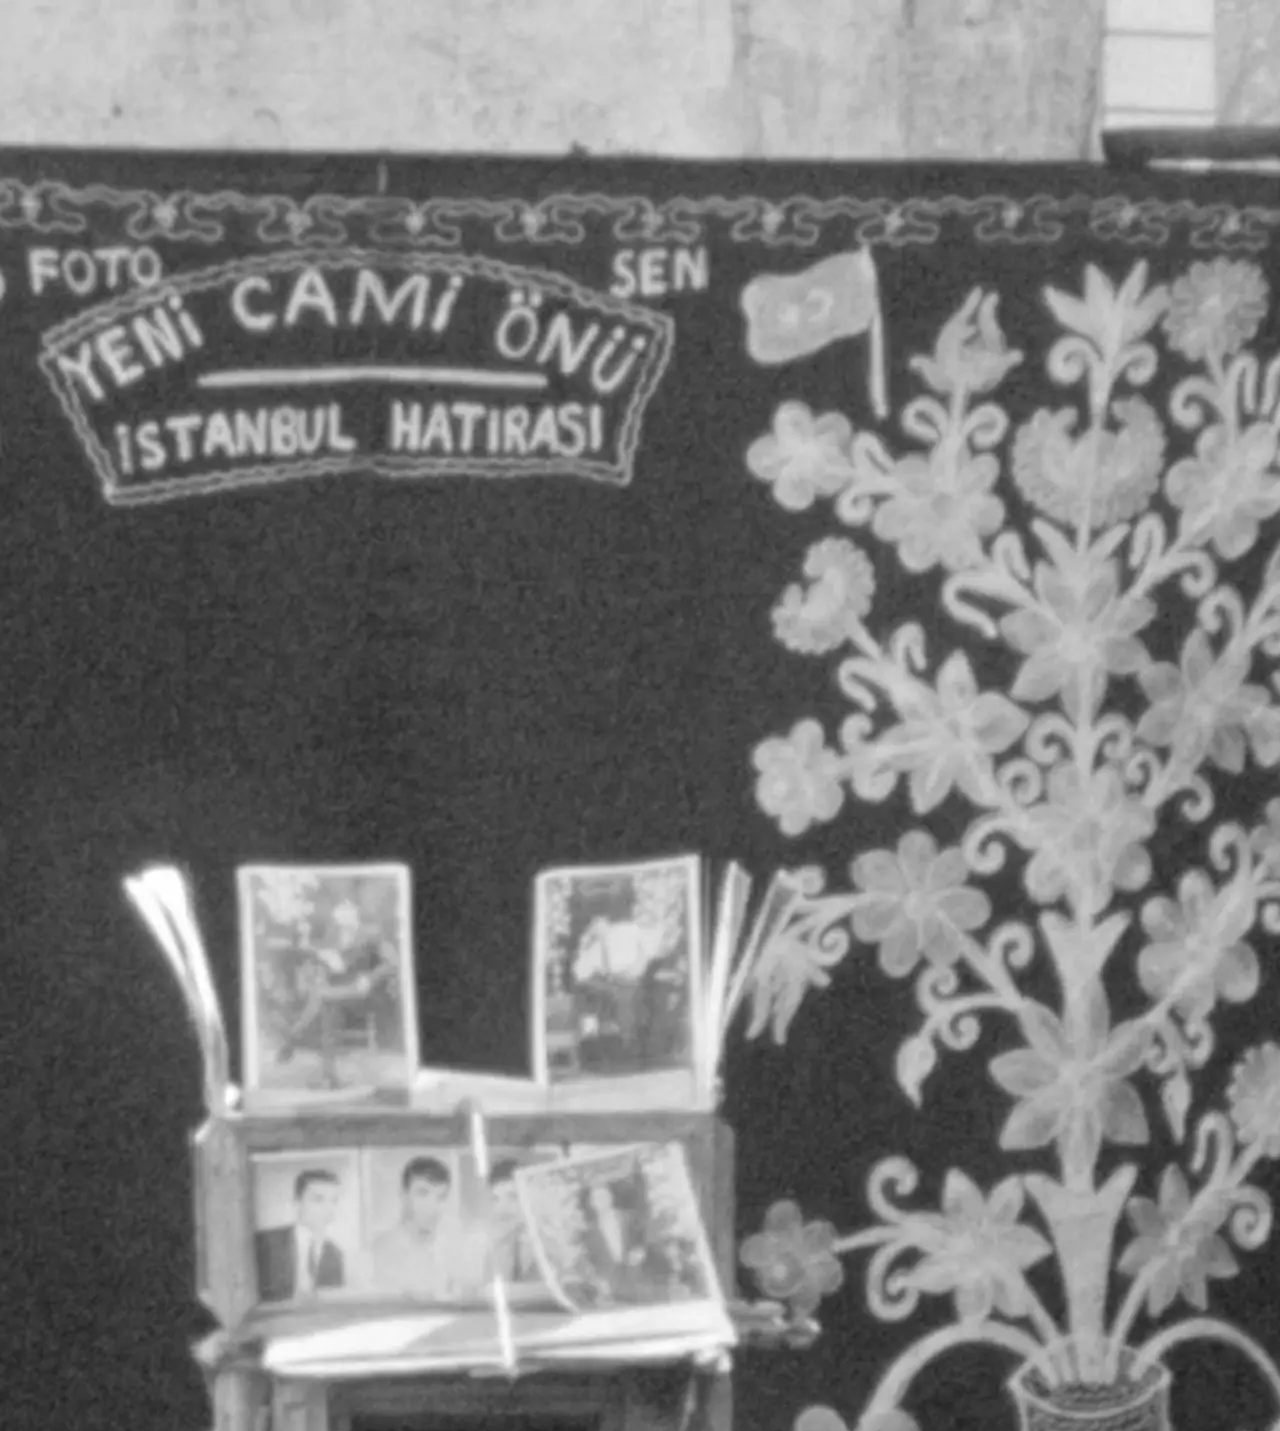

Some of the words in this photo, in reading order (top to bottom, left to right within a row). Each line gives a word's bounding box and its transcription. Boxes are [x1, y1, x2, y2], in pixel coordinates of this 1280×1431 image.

[27, 246, 163, 294] FOTO
[495, 291, 647, 393] ÖNÜ
[391, 400, 603, 456] HATIRASI
